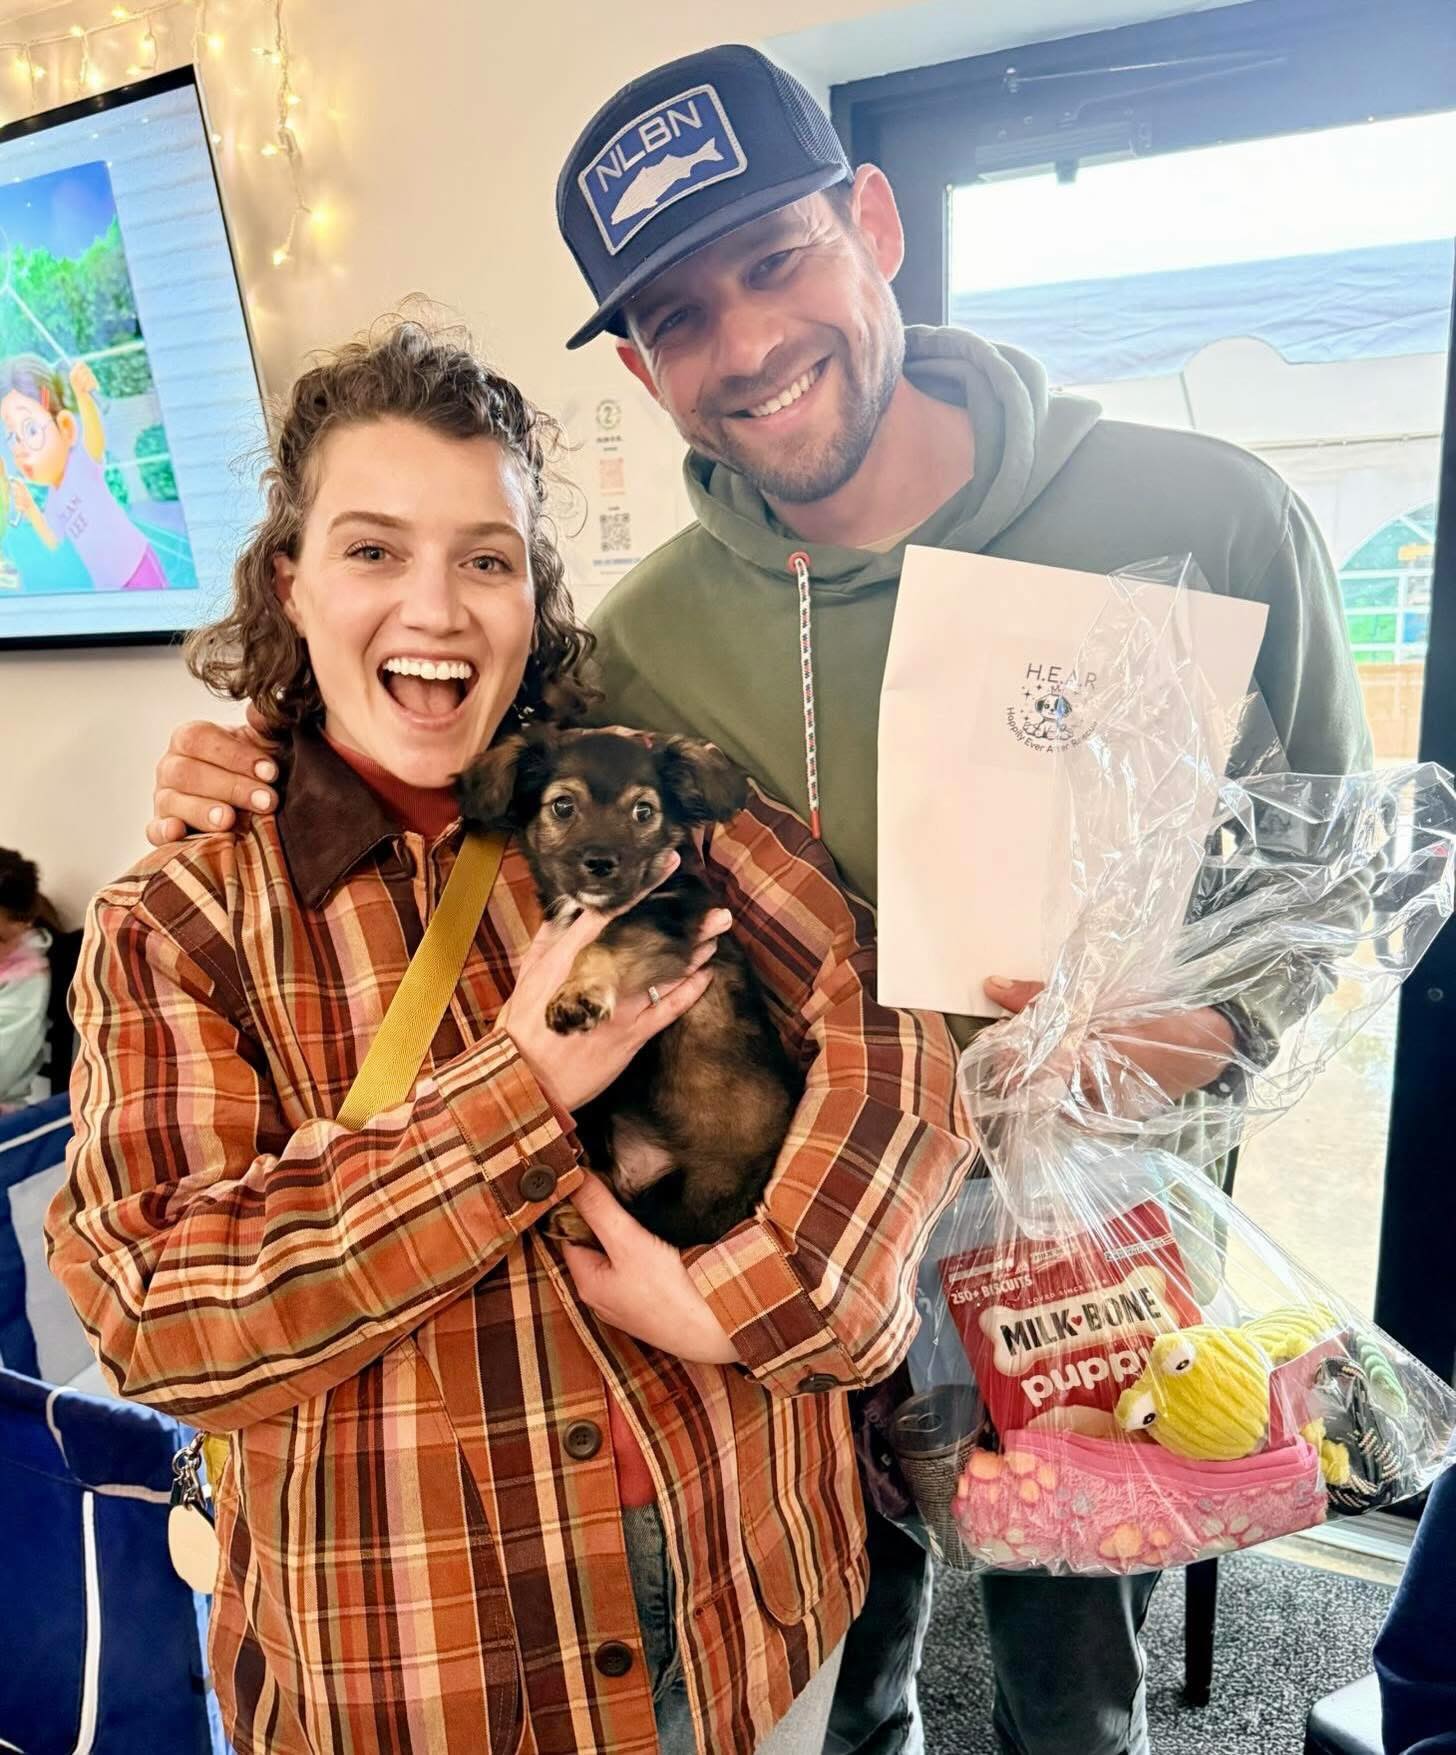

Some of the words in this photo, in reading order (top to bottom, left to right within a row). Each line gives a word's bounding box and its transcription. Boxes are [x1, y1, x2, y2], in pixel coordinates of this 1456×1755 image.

[595, 101, 703, 192] NLBN
[1007, 707, 1026, 741] Happily
[1024, 737, 1046, 751] Ever
[1046, 744, 1071, 752] Aer
[951, 1290, 980, 1305] 250+
[981, 1275, 1033, 1298] BISCUITS
